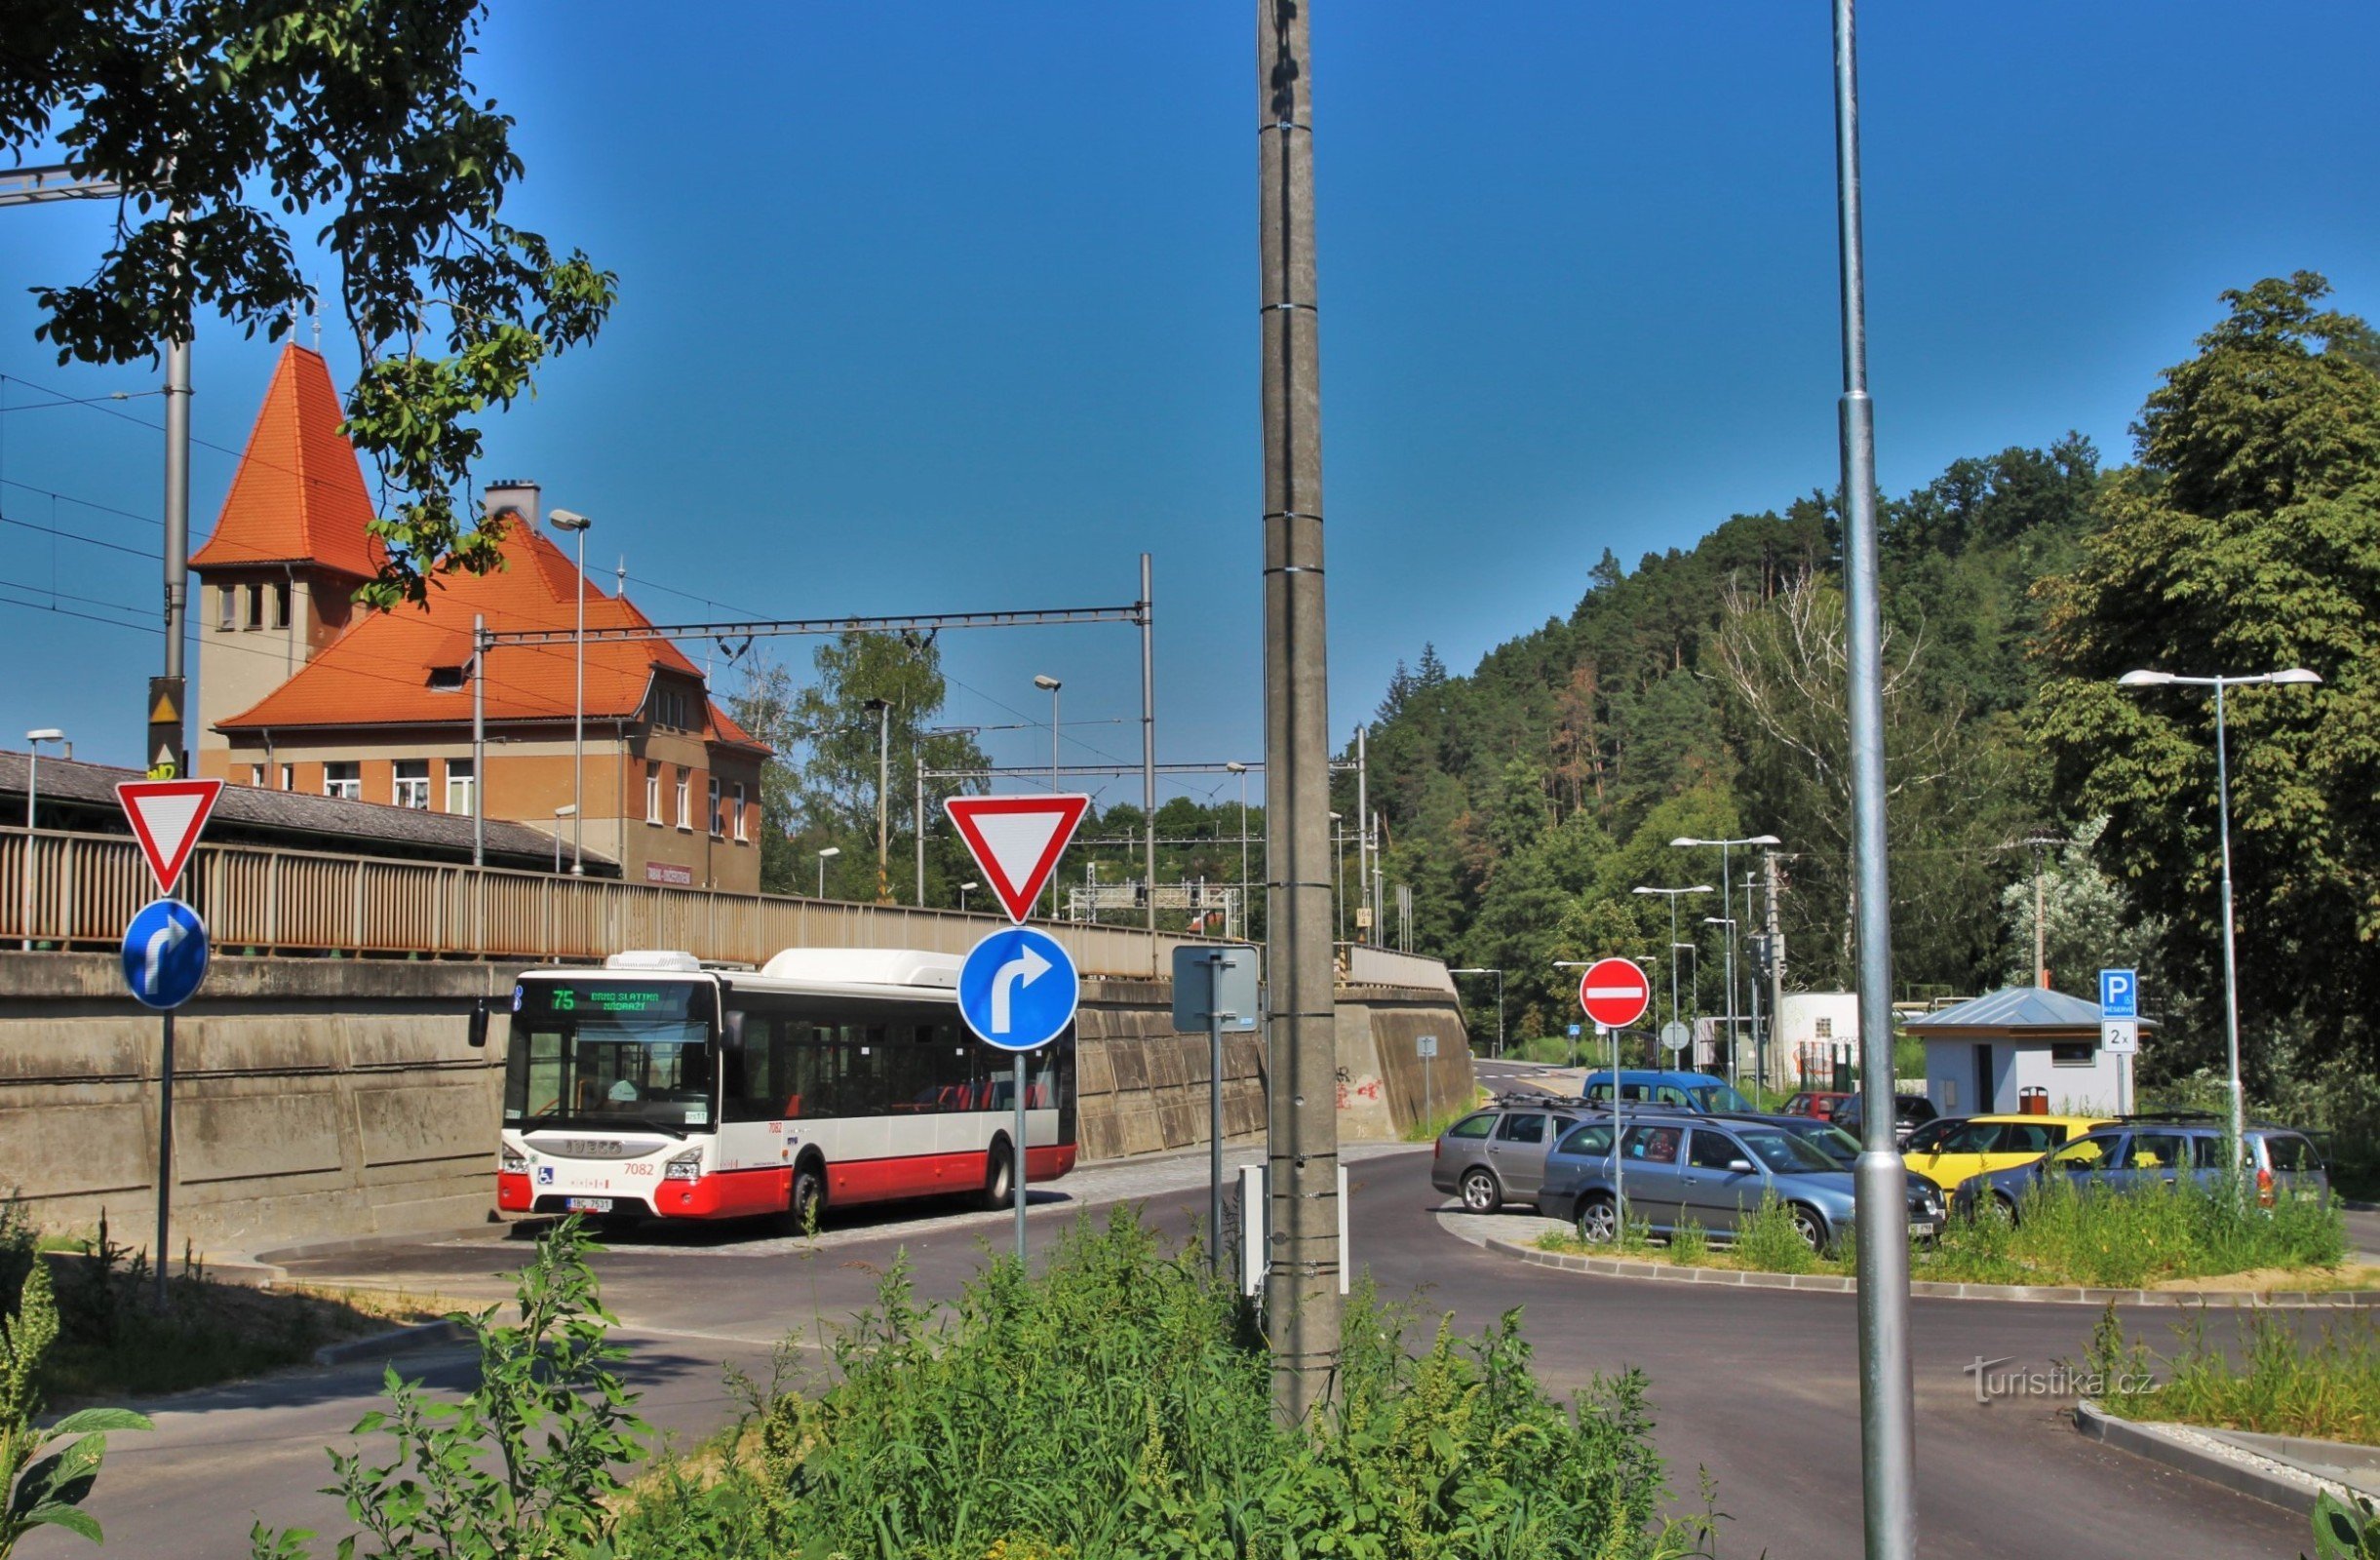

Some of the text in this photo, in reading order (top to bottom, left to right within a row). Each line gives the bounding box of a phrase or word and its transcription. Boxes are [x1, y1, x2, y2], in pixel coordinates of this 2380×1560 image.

[2108, 976, 2128, 1003] P
[552, 990, 574, 1010] 75
[768, 1121, 783, 1134] 7082
[566, 1140, 623, 1155] IVECO
[624, 1162, 654, 1176] 7082
